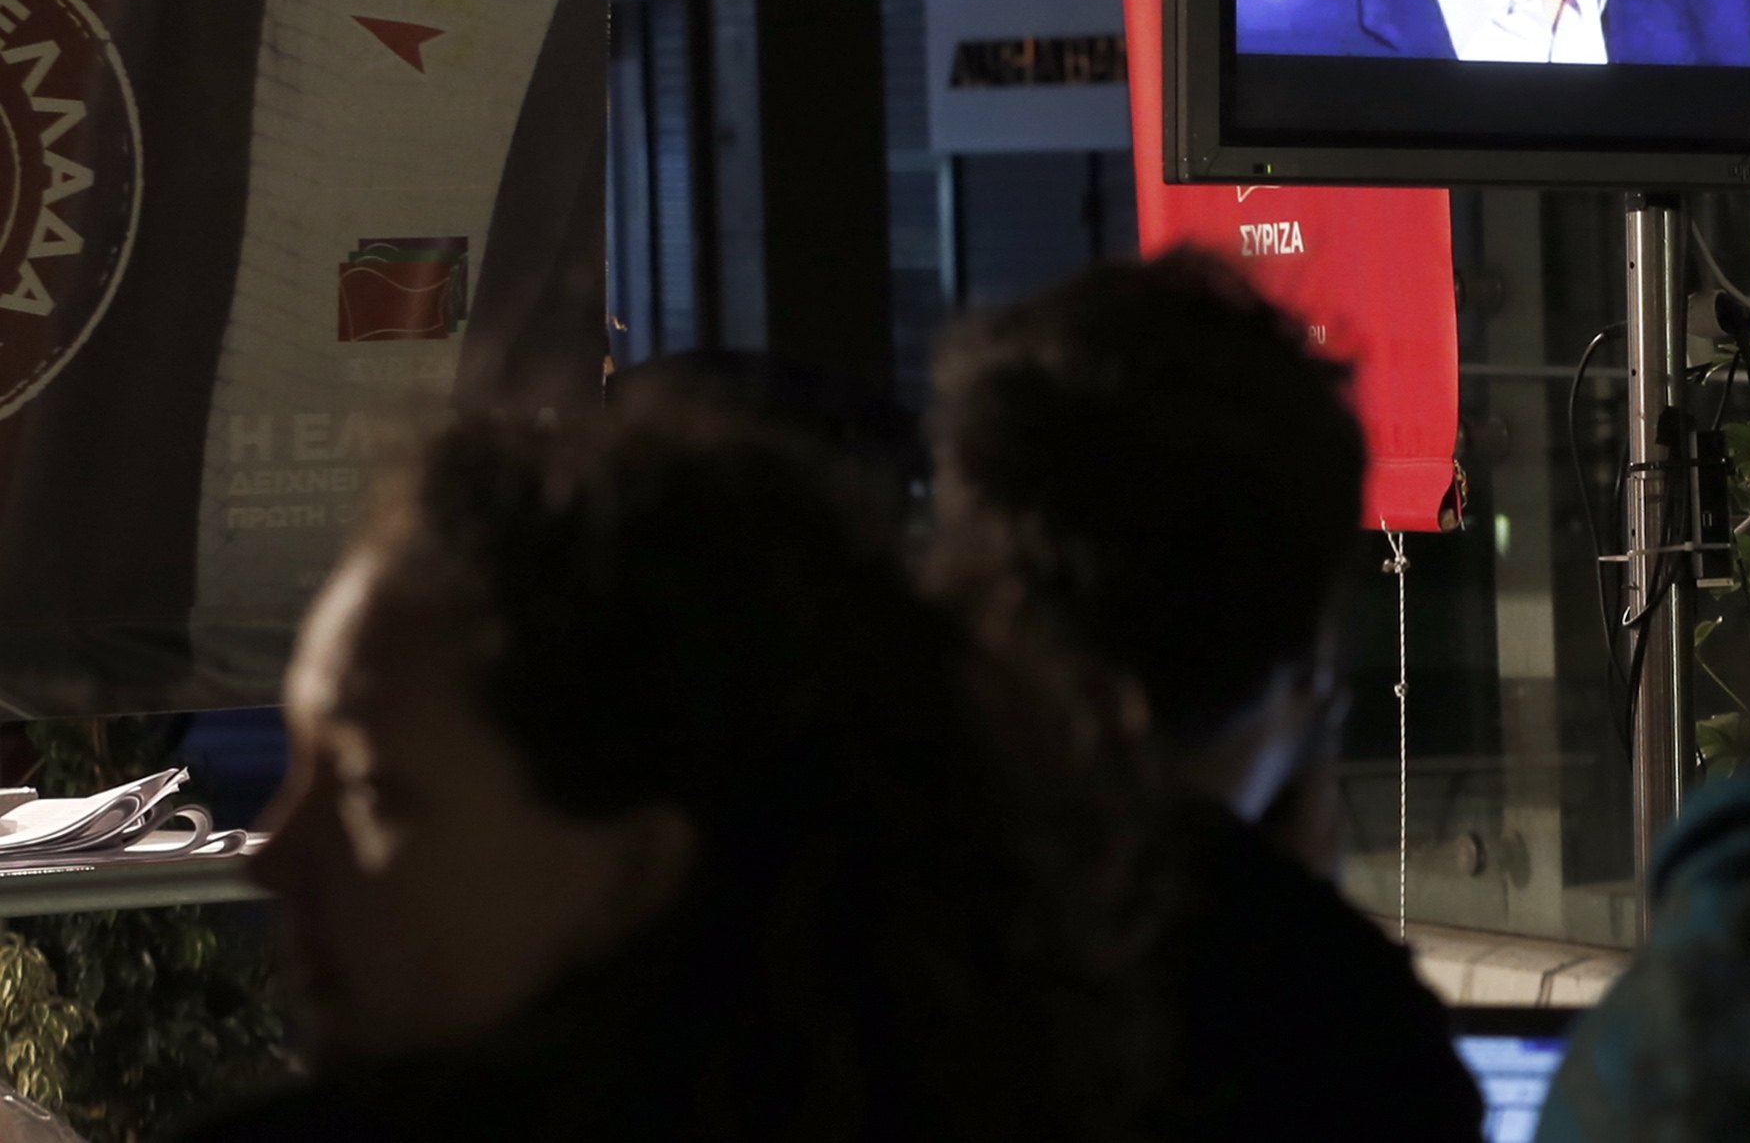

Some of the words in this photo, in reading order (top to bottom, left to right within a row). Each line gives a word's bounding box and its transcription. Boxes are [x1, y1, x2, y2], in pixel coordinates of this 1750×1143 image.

[1239, 221, 1304, 256] ΣΥΡΙΖΑ
[229, 414, 273, 462] Η
[228, 467, 359, 495] ΔΕΙΧΝΕΙ
